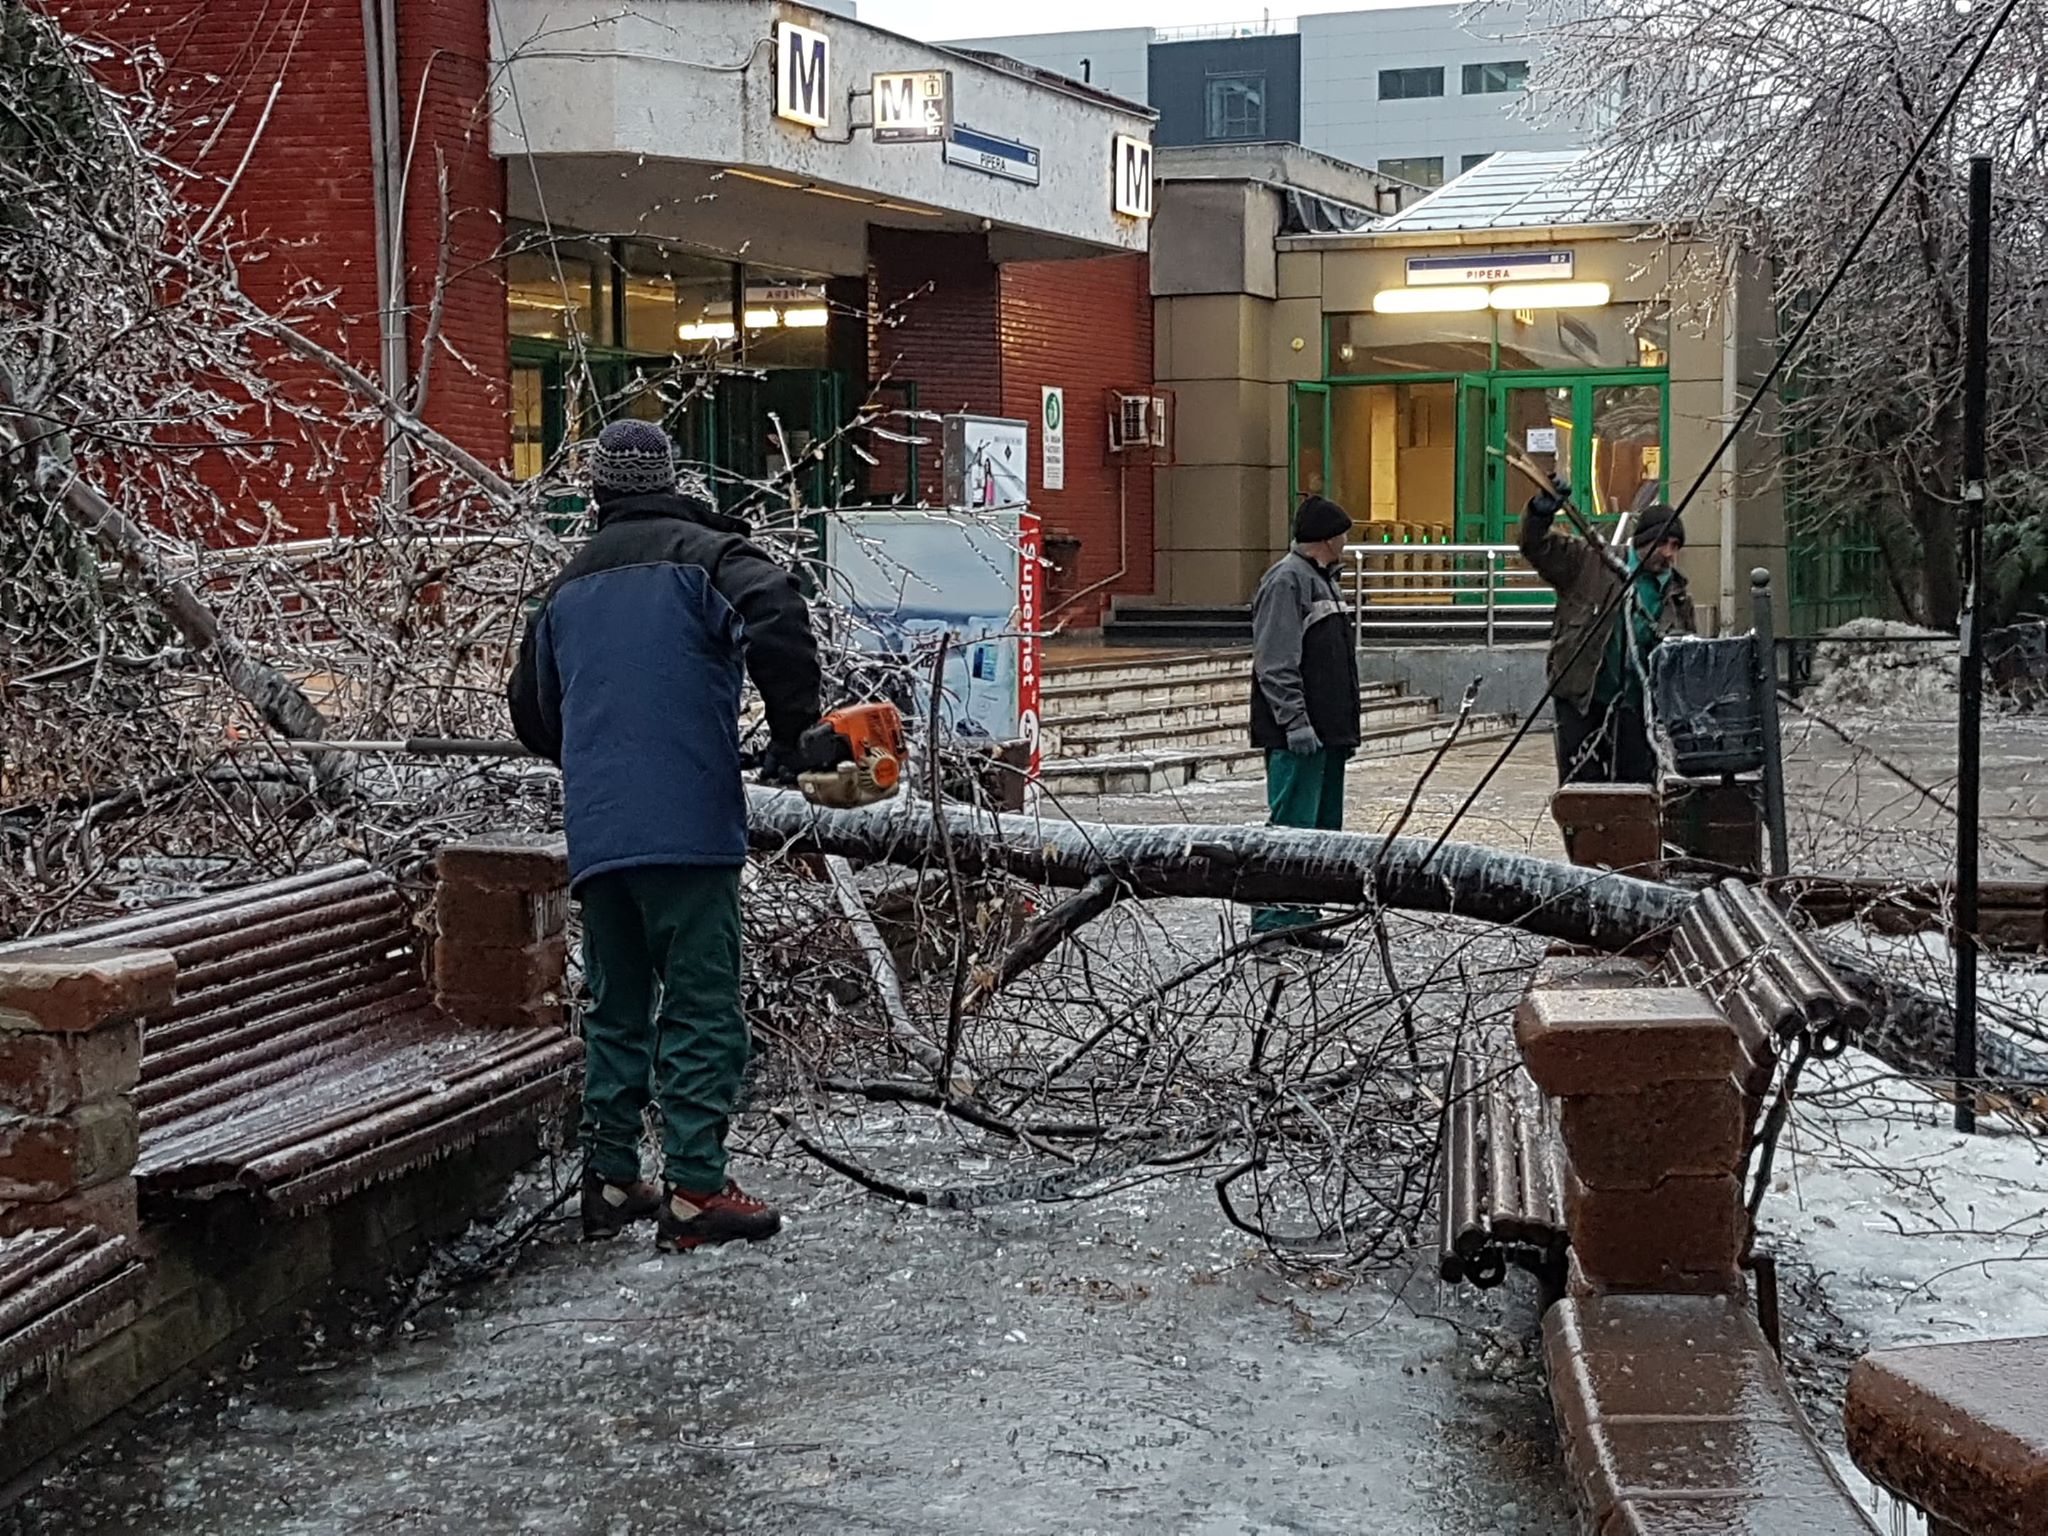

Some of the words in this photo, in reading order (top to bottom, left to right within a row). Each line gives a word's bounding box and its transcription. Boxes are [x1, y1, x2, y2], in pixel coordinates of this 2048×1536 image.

[789, 31, 825, 120] M
[881, 78, 913, 121] M
[979, 153, 1007, 172] PIPERA
[1126, 143, 1149, 212] M
[1466, 269, 1510, 280] PIPERA
[1021, 541, 1036, 687] Supernet
